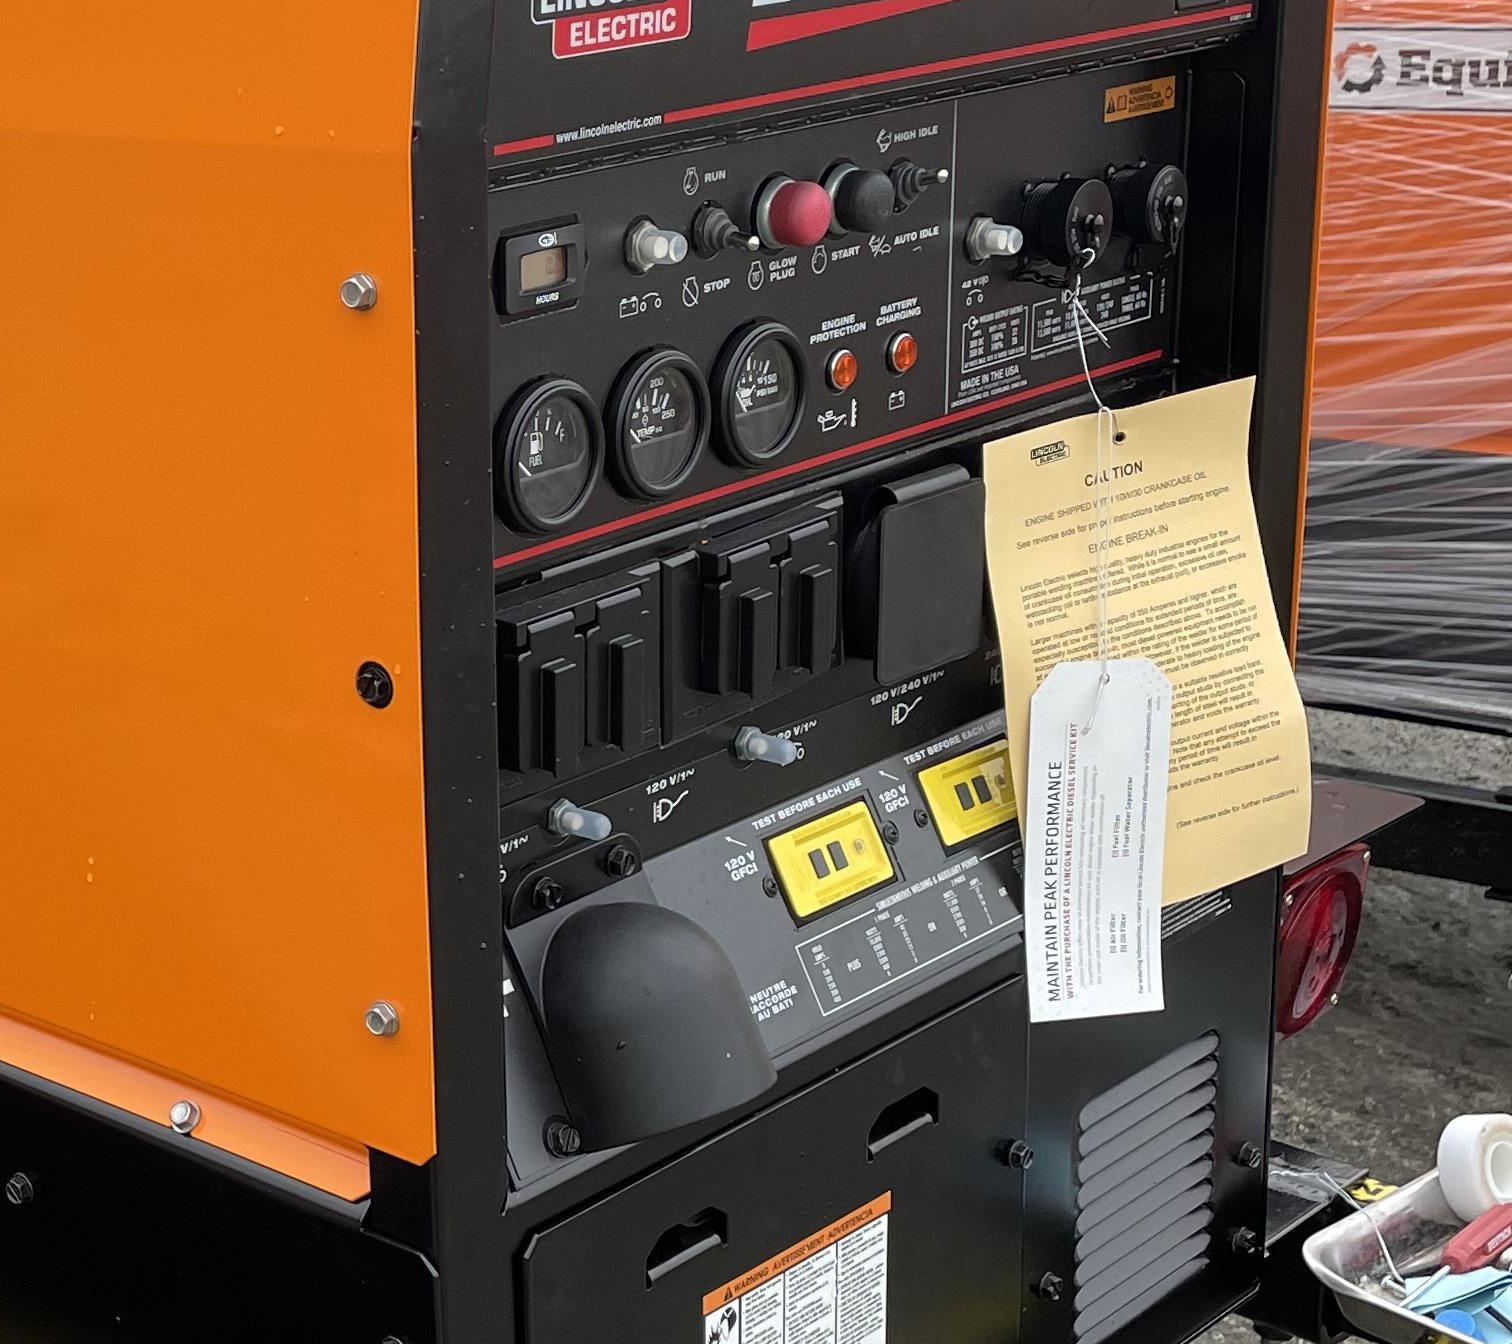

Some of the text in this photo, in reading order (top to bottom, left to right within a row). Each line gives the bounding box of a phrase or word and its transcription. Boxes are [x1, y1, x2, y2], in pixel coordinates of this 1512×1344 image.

[570, 7, 677, 47] ELECTRIC
[556, 113, 663, 143] www.lincolnelectric.com
[894, 125, 939, 143] HIGH IDLE
[704, 169, 727, 183] RUN
[894, 226, 940, 246] AUTO IDLE
[831, 246, 861, 261] START
[769, 256, 797, 271] GLOW
[770, 268, 796, 282] PLUG
[703, 278, 731, 293] STOP
[880, 297, 918, 315] BATTERY
[822, 314, 856, 330] ENGINE
[876, 307, 921, 326] CHARGING
[810, 321, 866, 345] PROTECTION
[649, 376, 664, 388] 200
[960, 364, 1019, 391] MADE IN THE USA
[661, 408, 675, 420] 250
[559, 428, 565, 442] F
[637, 426, 655, 437] TEMP
[1025, 512, 1055, 527] ENGINE
[1057, 502, 1092, 519] SHIPPED
[1143, 476, 1192, 496] CRANKCASE
[1194, 471, 1207, 483] OIL
[1017, 540, 1030, 550] See
[1032, 532, 1059, 545] reverse
[1061, 528, 1075, 538] side
[1077, 524, 1087, 535] for
[1113, 507, 1153, 523] instructions
[1154, 500, 1176, 513] before
[1126, 524, 1168, 543] BREAK-IN
[871, 678, 920, 705] 120 V/240
[1070, 722, 1078, 737] KIT
[904, 717, 1003, 765] TEST BEFORE EACH USE
[1068, 739, 1077, 775] SERVICE
[646, 779, 667, 795] 120
[879, 784, 906, 803] 120 V
[1067, 777, 1076, 806] DIESEL
[752, 777, 863, 831] TEST BEFORE EACH USE
[885, 798, 909, 813] GFCI
[1065, 809, 1074, 848] ELECTRIC
[724, 850, 755, 872] 120 V
[1063, 850, 1072, 886] LINCOLN
[731, 864, 758, 882] GFCI
[1044, 761, 1062, 1001] MAINTAIN PEAK PERFORMANCE
[1063, 896, 1071, 906] OF
[1063, 909, 1071, 953] PURCHASE
[1064, 956, 1072, 973] THE
[750, 980, 786, 1003] NEUTRE
[1065, 975, 1074, 999] WITH
[758, 999, 793, 1022] AU BATI
[733, 1268, 769, 1294] WARNING
